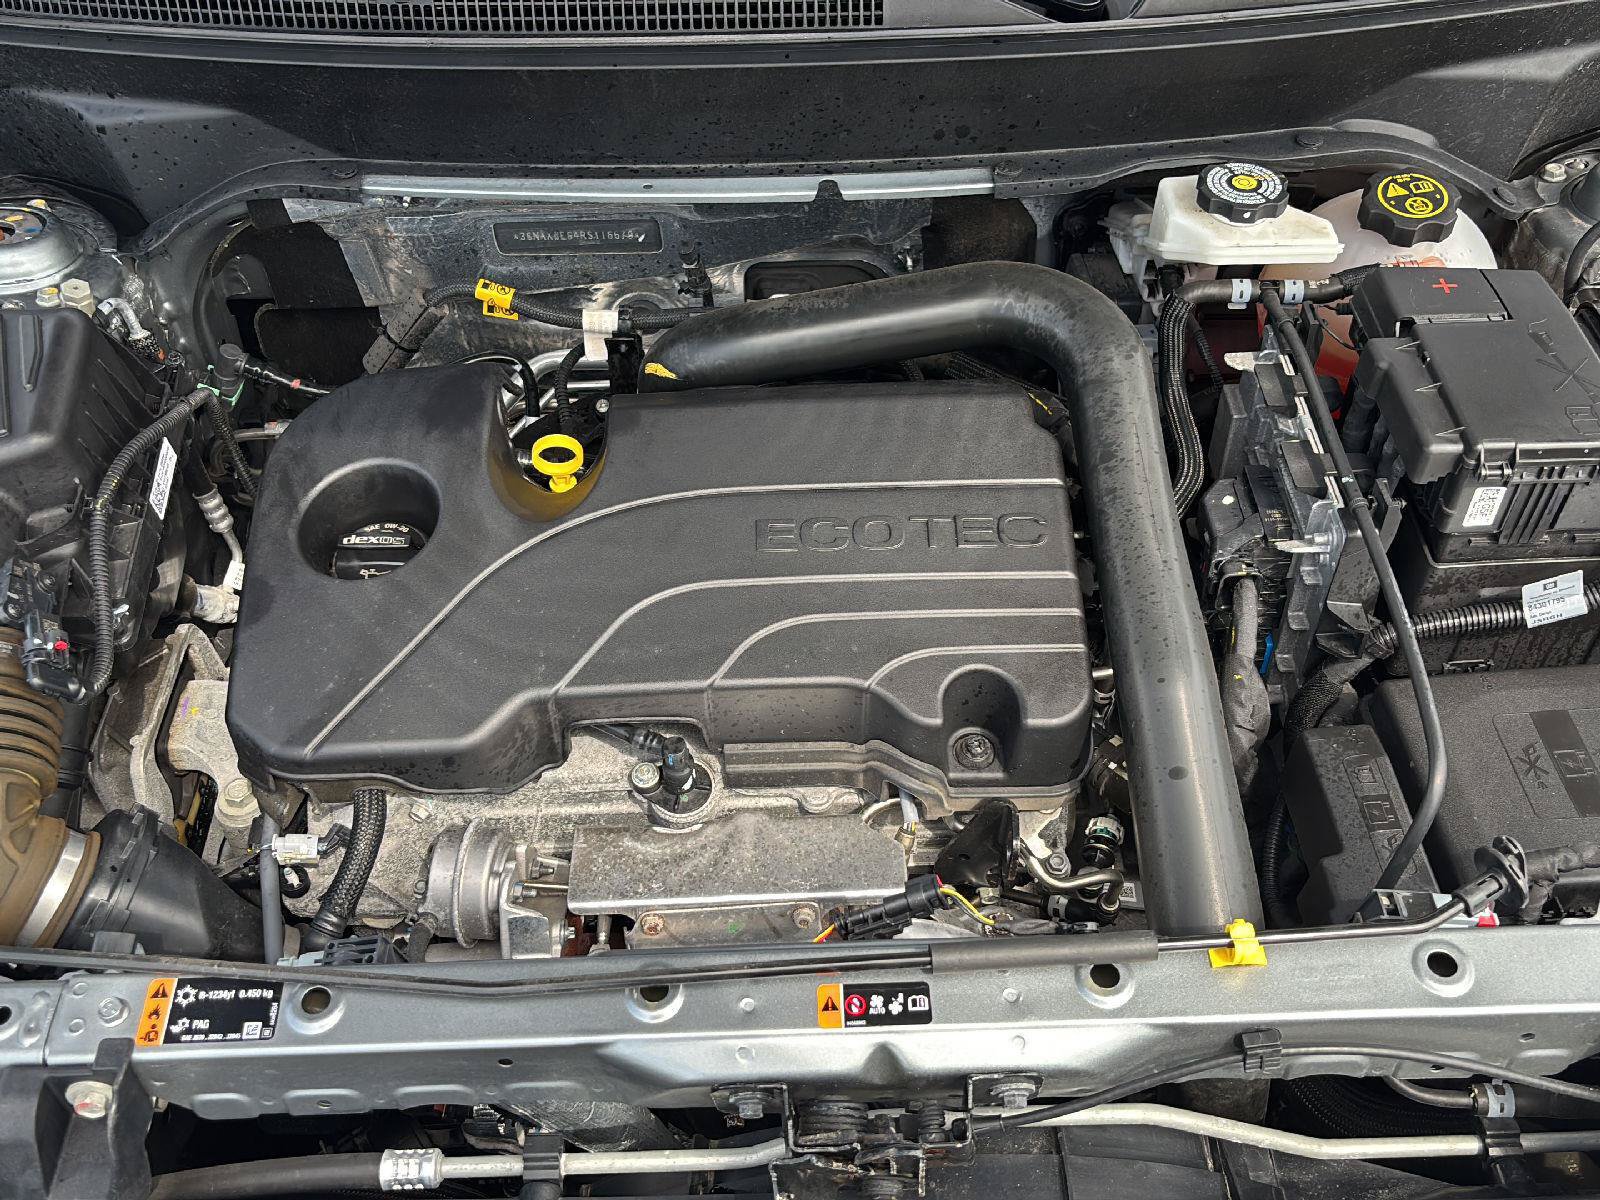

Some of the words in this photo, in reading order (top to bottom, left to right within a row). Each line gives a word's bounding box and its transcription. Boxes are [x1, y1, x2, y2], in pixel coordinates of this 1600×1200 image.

[755, 512, 1048, 552] ECOTEC
[342, 534, 406, 545] dexos
[191, 1019, 210, 1029] PAG
